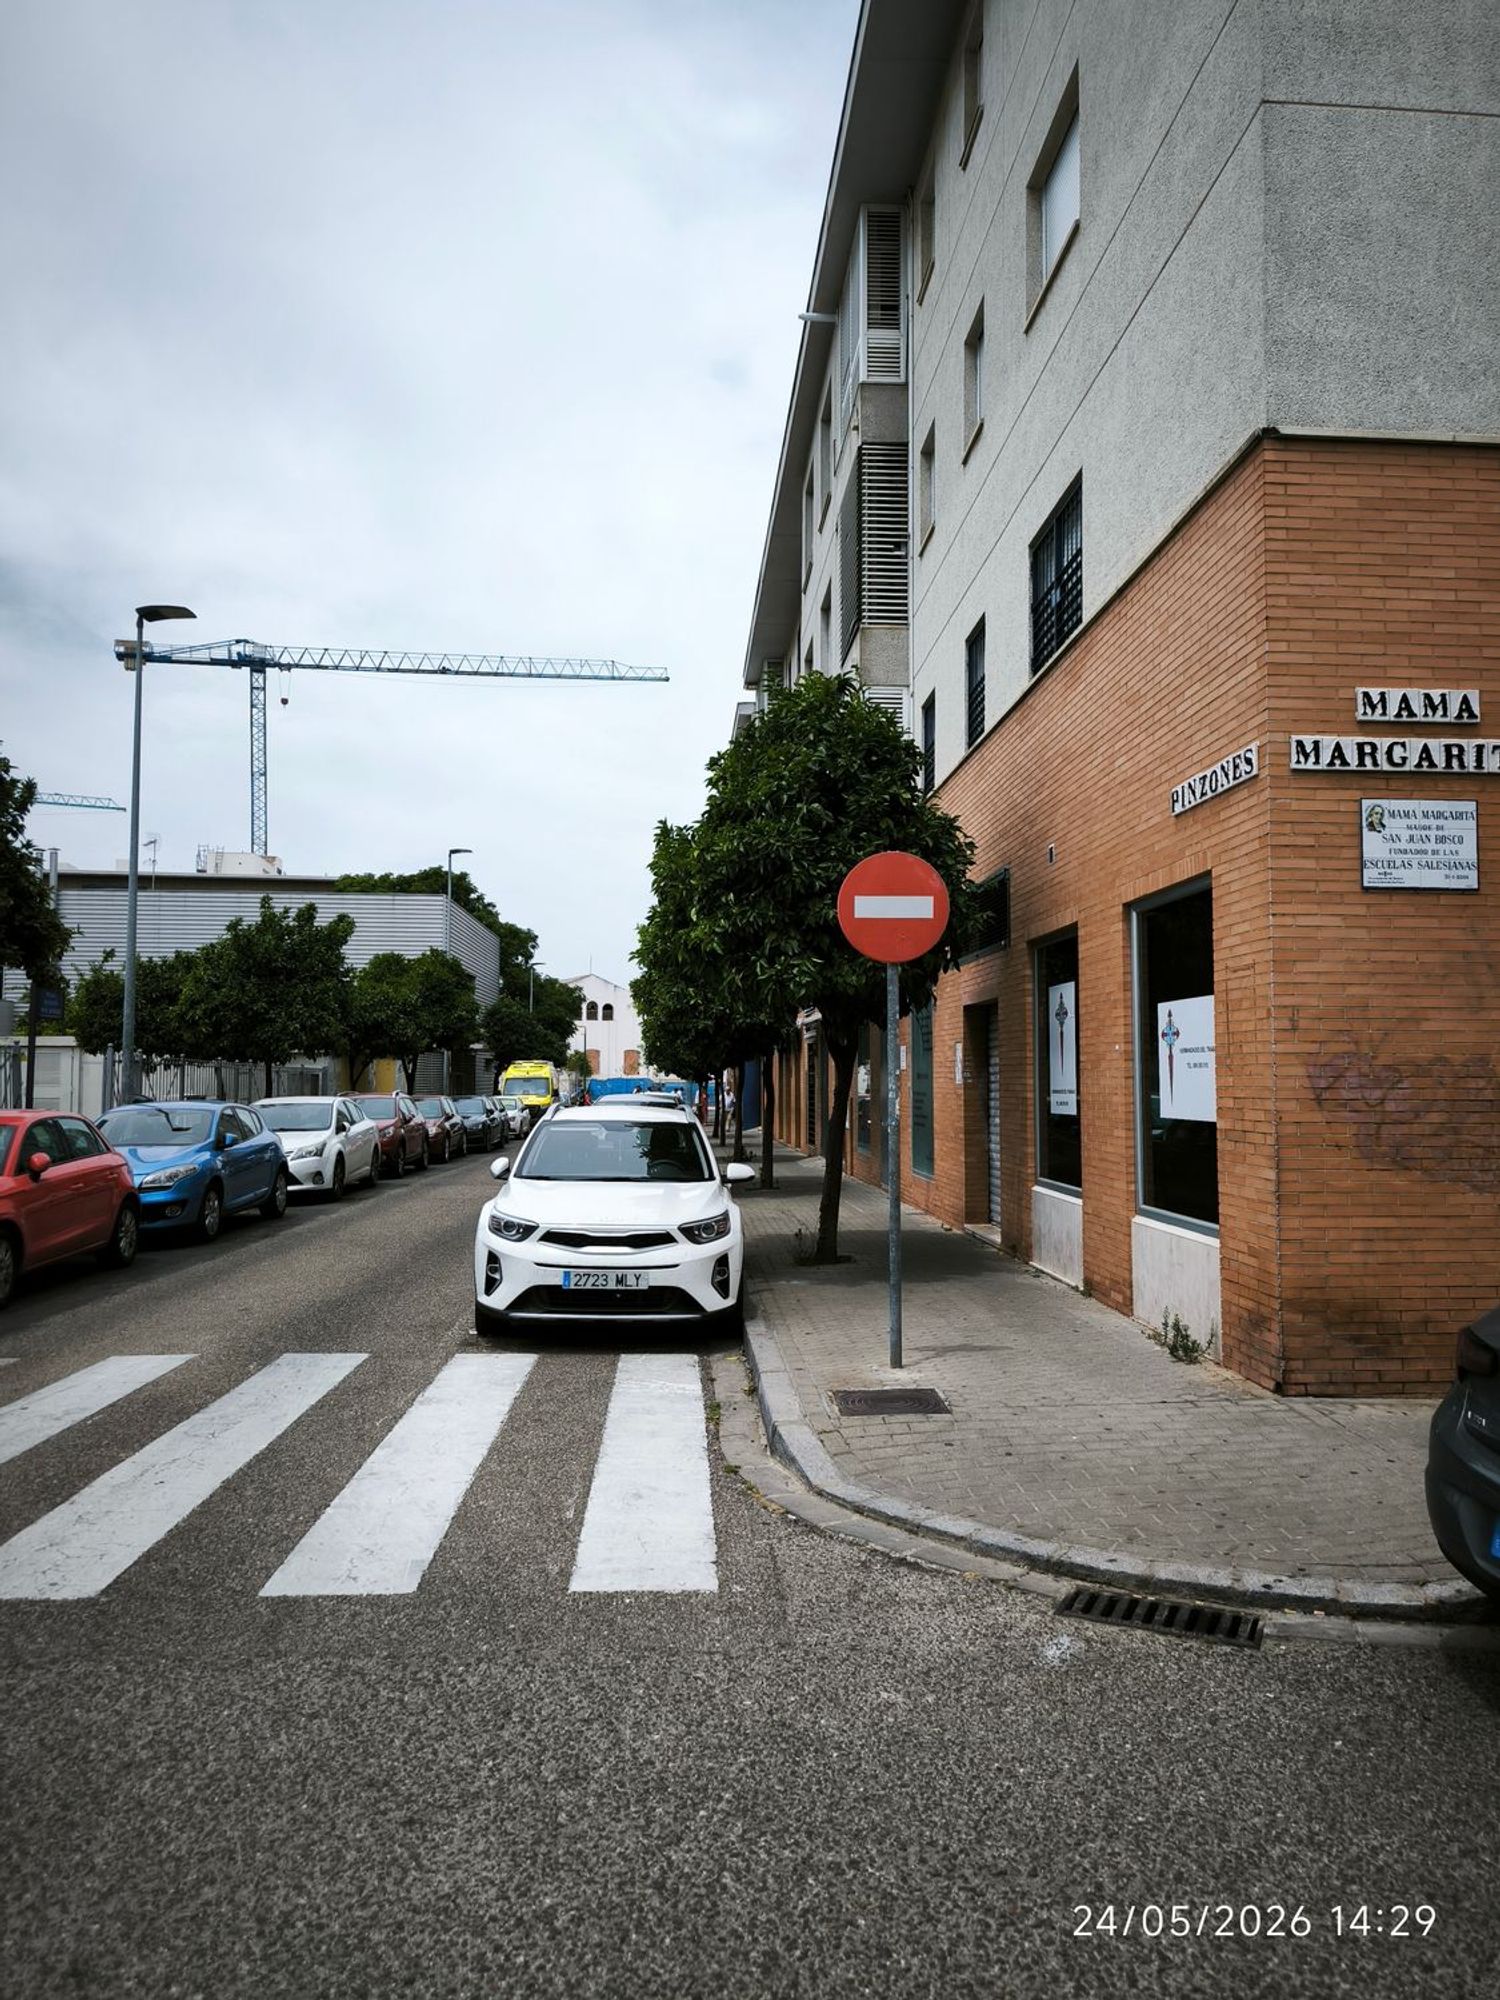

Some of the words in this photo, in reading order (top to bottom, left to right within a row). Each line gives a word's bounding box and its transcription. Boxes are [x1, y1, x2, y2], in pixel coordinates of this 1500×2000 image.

[1361, 691, 1478, 720] MAMA
[1171, 748, 1254, 813] PINZONES
[1382, 833, 1401, 843] SAN
[1405, 834, 1431, 844] JUAN
[1434, 834, 1464, 845] BOSCO
[1364, 860, 1413, 870] ESCUELAS
[1417, 860, 1477, 871] SALESIANAS
[574, 1274, 608, 1287] 2723
[615, 1274, 641, 1287] MLY
